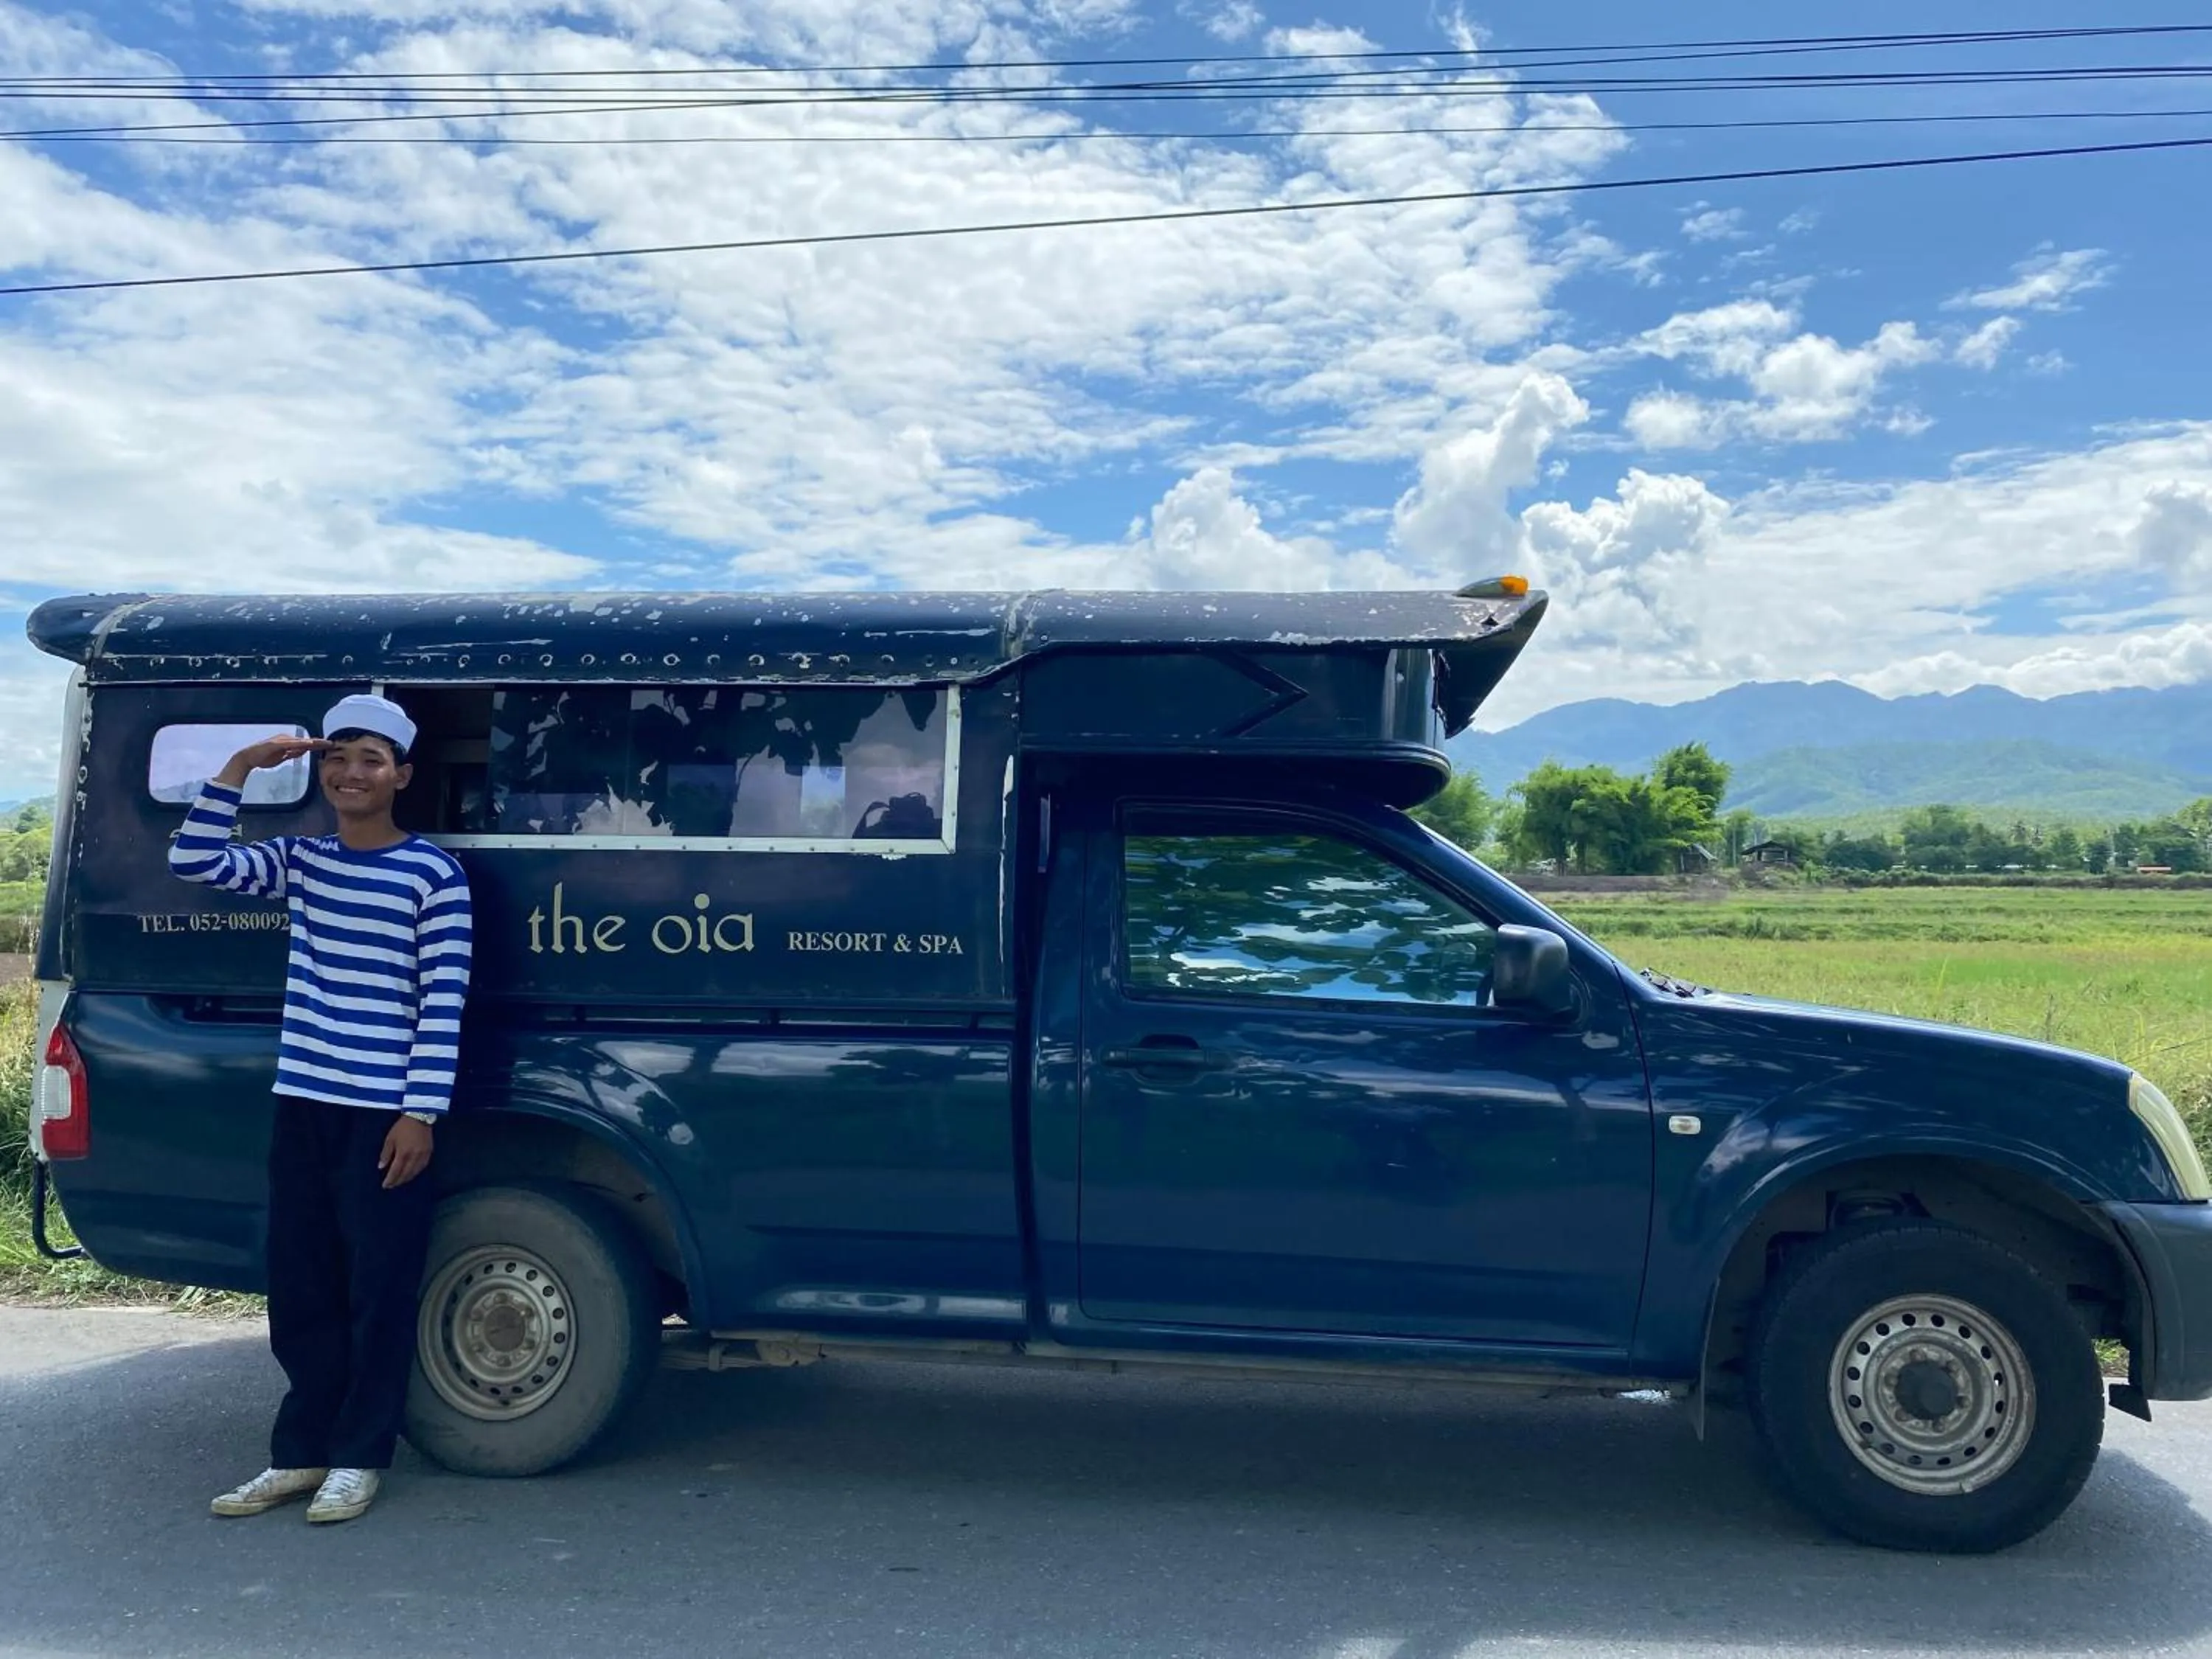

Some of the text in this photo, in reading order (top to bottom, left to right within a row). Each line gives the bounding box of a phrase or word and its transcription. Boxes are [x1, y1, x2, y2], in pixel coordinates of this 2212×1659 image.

[138, 912, 291, 933] TEL. 052-080092
[527, 881, 964, 955] the oia RESORT & SPA
